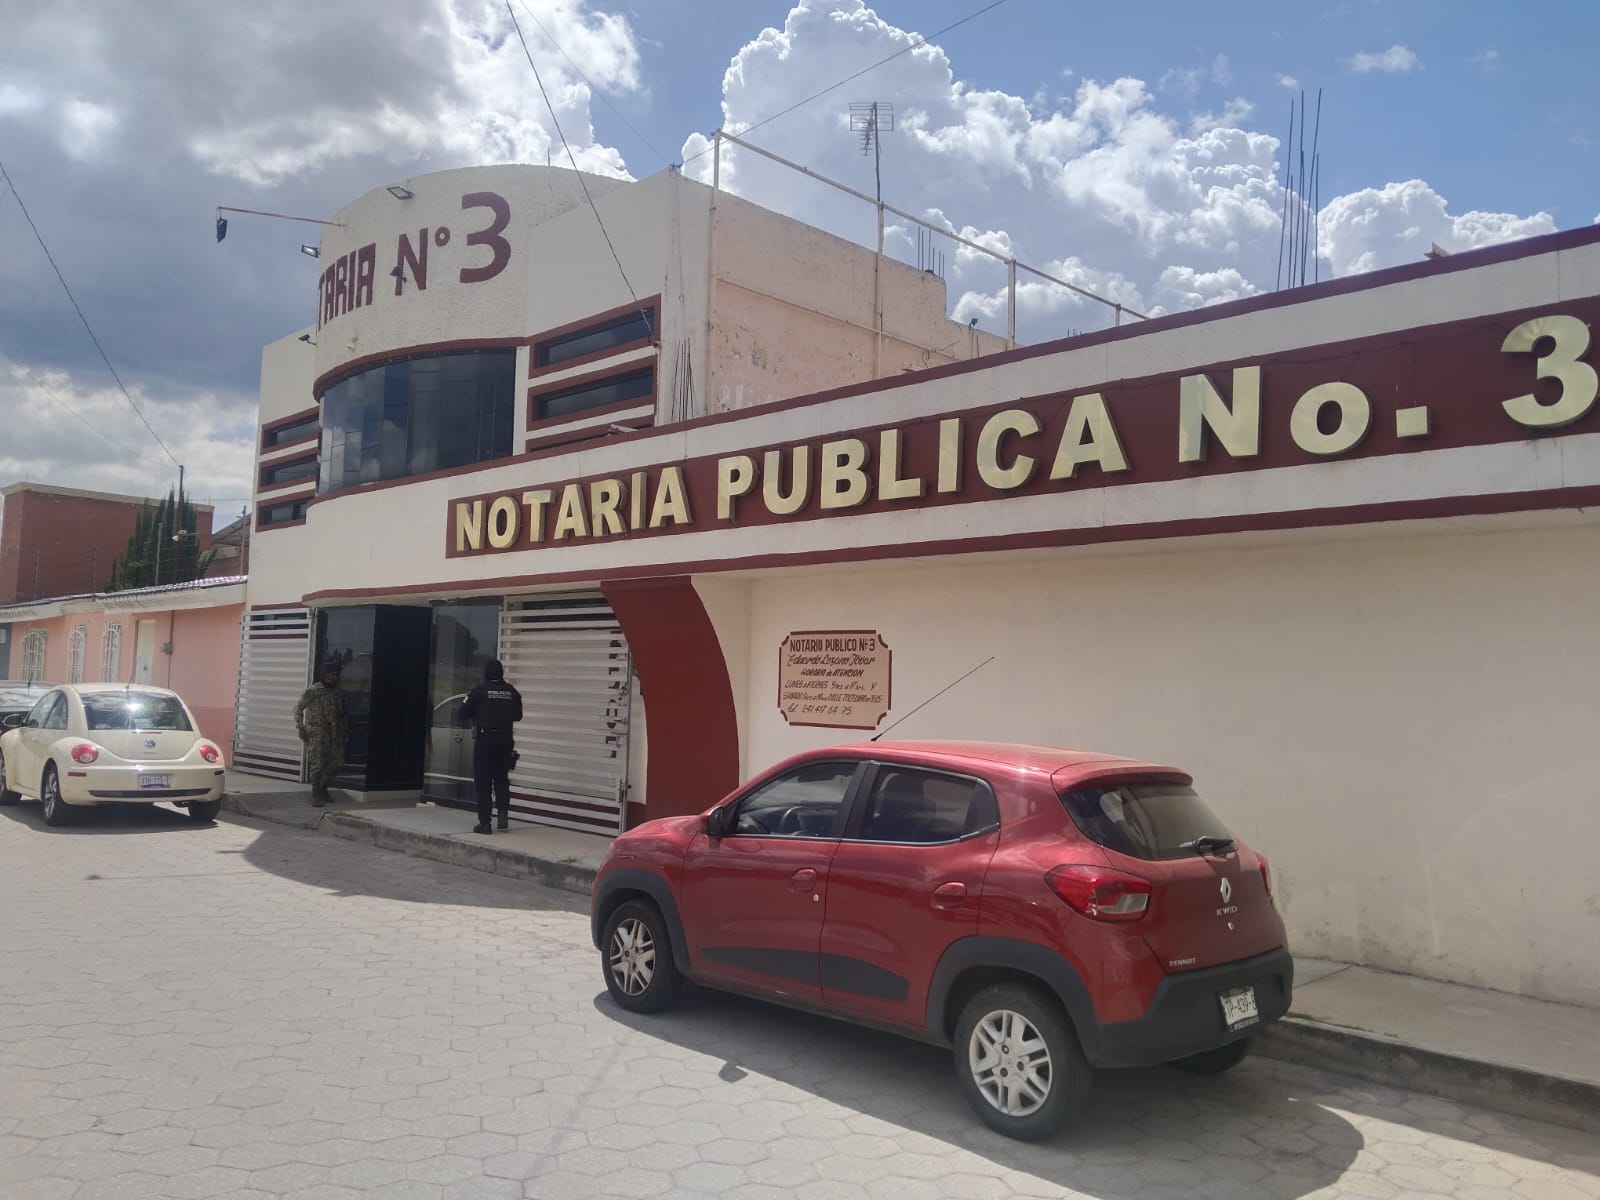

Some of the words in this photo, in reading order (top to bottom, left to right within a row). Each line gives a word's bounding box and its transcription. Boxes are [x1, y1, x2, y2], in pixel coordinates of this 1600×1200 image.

[319, 242, 376, 332] TARIA
[459, 191, 512, 284] 3
[456, 466, 694, 552] NOTARIA
[717, 391, 1133, 520] PUBLICA
[1178, 365, 1430, 463] No.
[1500, 314, 1600, 429] 3
[790, 639, 823, 652] NOTARIO
[825, 638, 857, 652] PUBLICO
[1216, 905, 1238, 917] KWID
